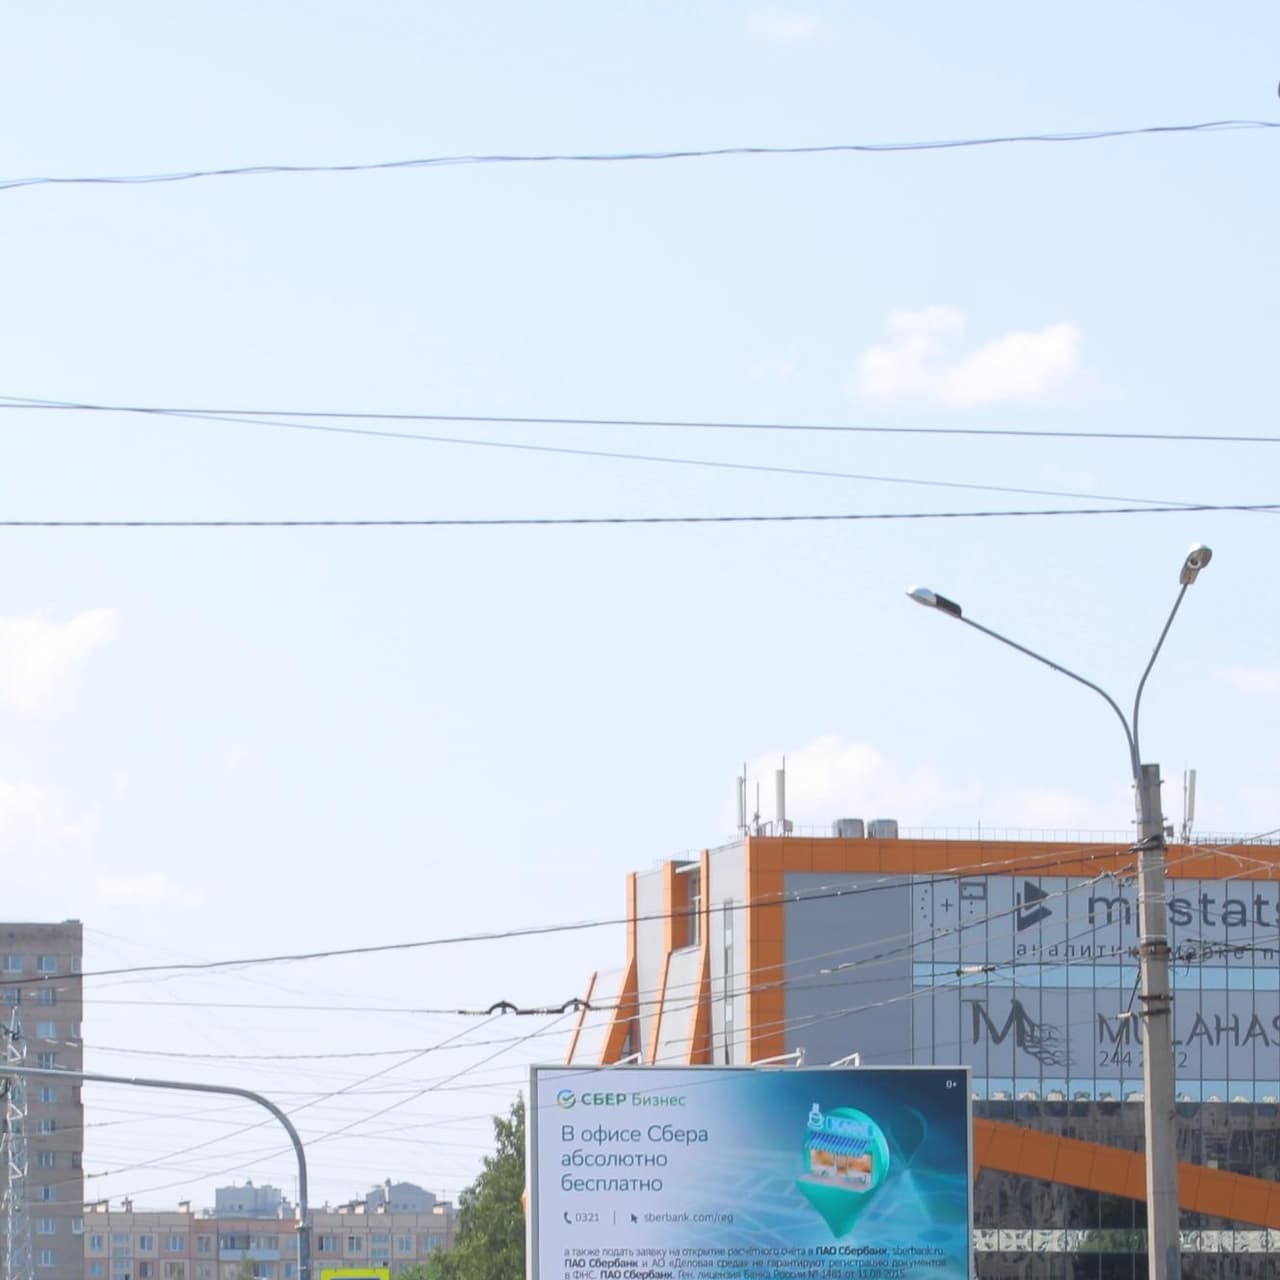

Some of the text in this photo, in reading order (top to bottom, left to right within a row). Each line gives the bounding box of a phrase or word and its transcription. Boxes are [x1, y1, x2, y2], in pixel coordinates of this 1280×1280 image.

[1016, 942, 1142, 958] аналитик
[1099, 1051, 1131, 1068] 244
[581, 1092, 686, 1107] СБЕР Бизнес
[562, 1124, 709, 1146] В офисе Сбера
[561, 1148, 668, 1167] абсолютно
[561, 1173, 663, 1192] бесплатно
[575, 1212, 600, 1223] 0321
[571, 1248, 600, 1256] также
[602, 1249, 634, 1257] подать
[636, 1248, 667, 1257] заявку
[669, 1248, 680, 1256] на
[682, 1247, 724, 1257] открытие
[816, 1246, 837, 1256] ПАО
[838, 1245, 890, 1257] Сбербанк,
[565, 1258, 586, 1268] ПАО
[588, 1258, 638, 1270] Сбербанк
[652, 1259, 666, 1268] АО
[767, 1258, 825, 1269] гарантируют
[600, 1270, 621, 1280] ПАО
[697, 1270, 741, 1280] лицензия
[743, 1269, 770, 1280] Банка
[773, 1269, 807, 1280] России
[846, 1271, 855, 1279] от
